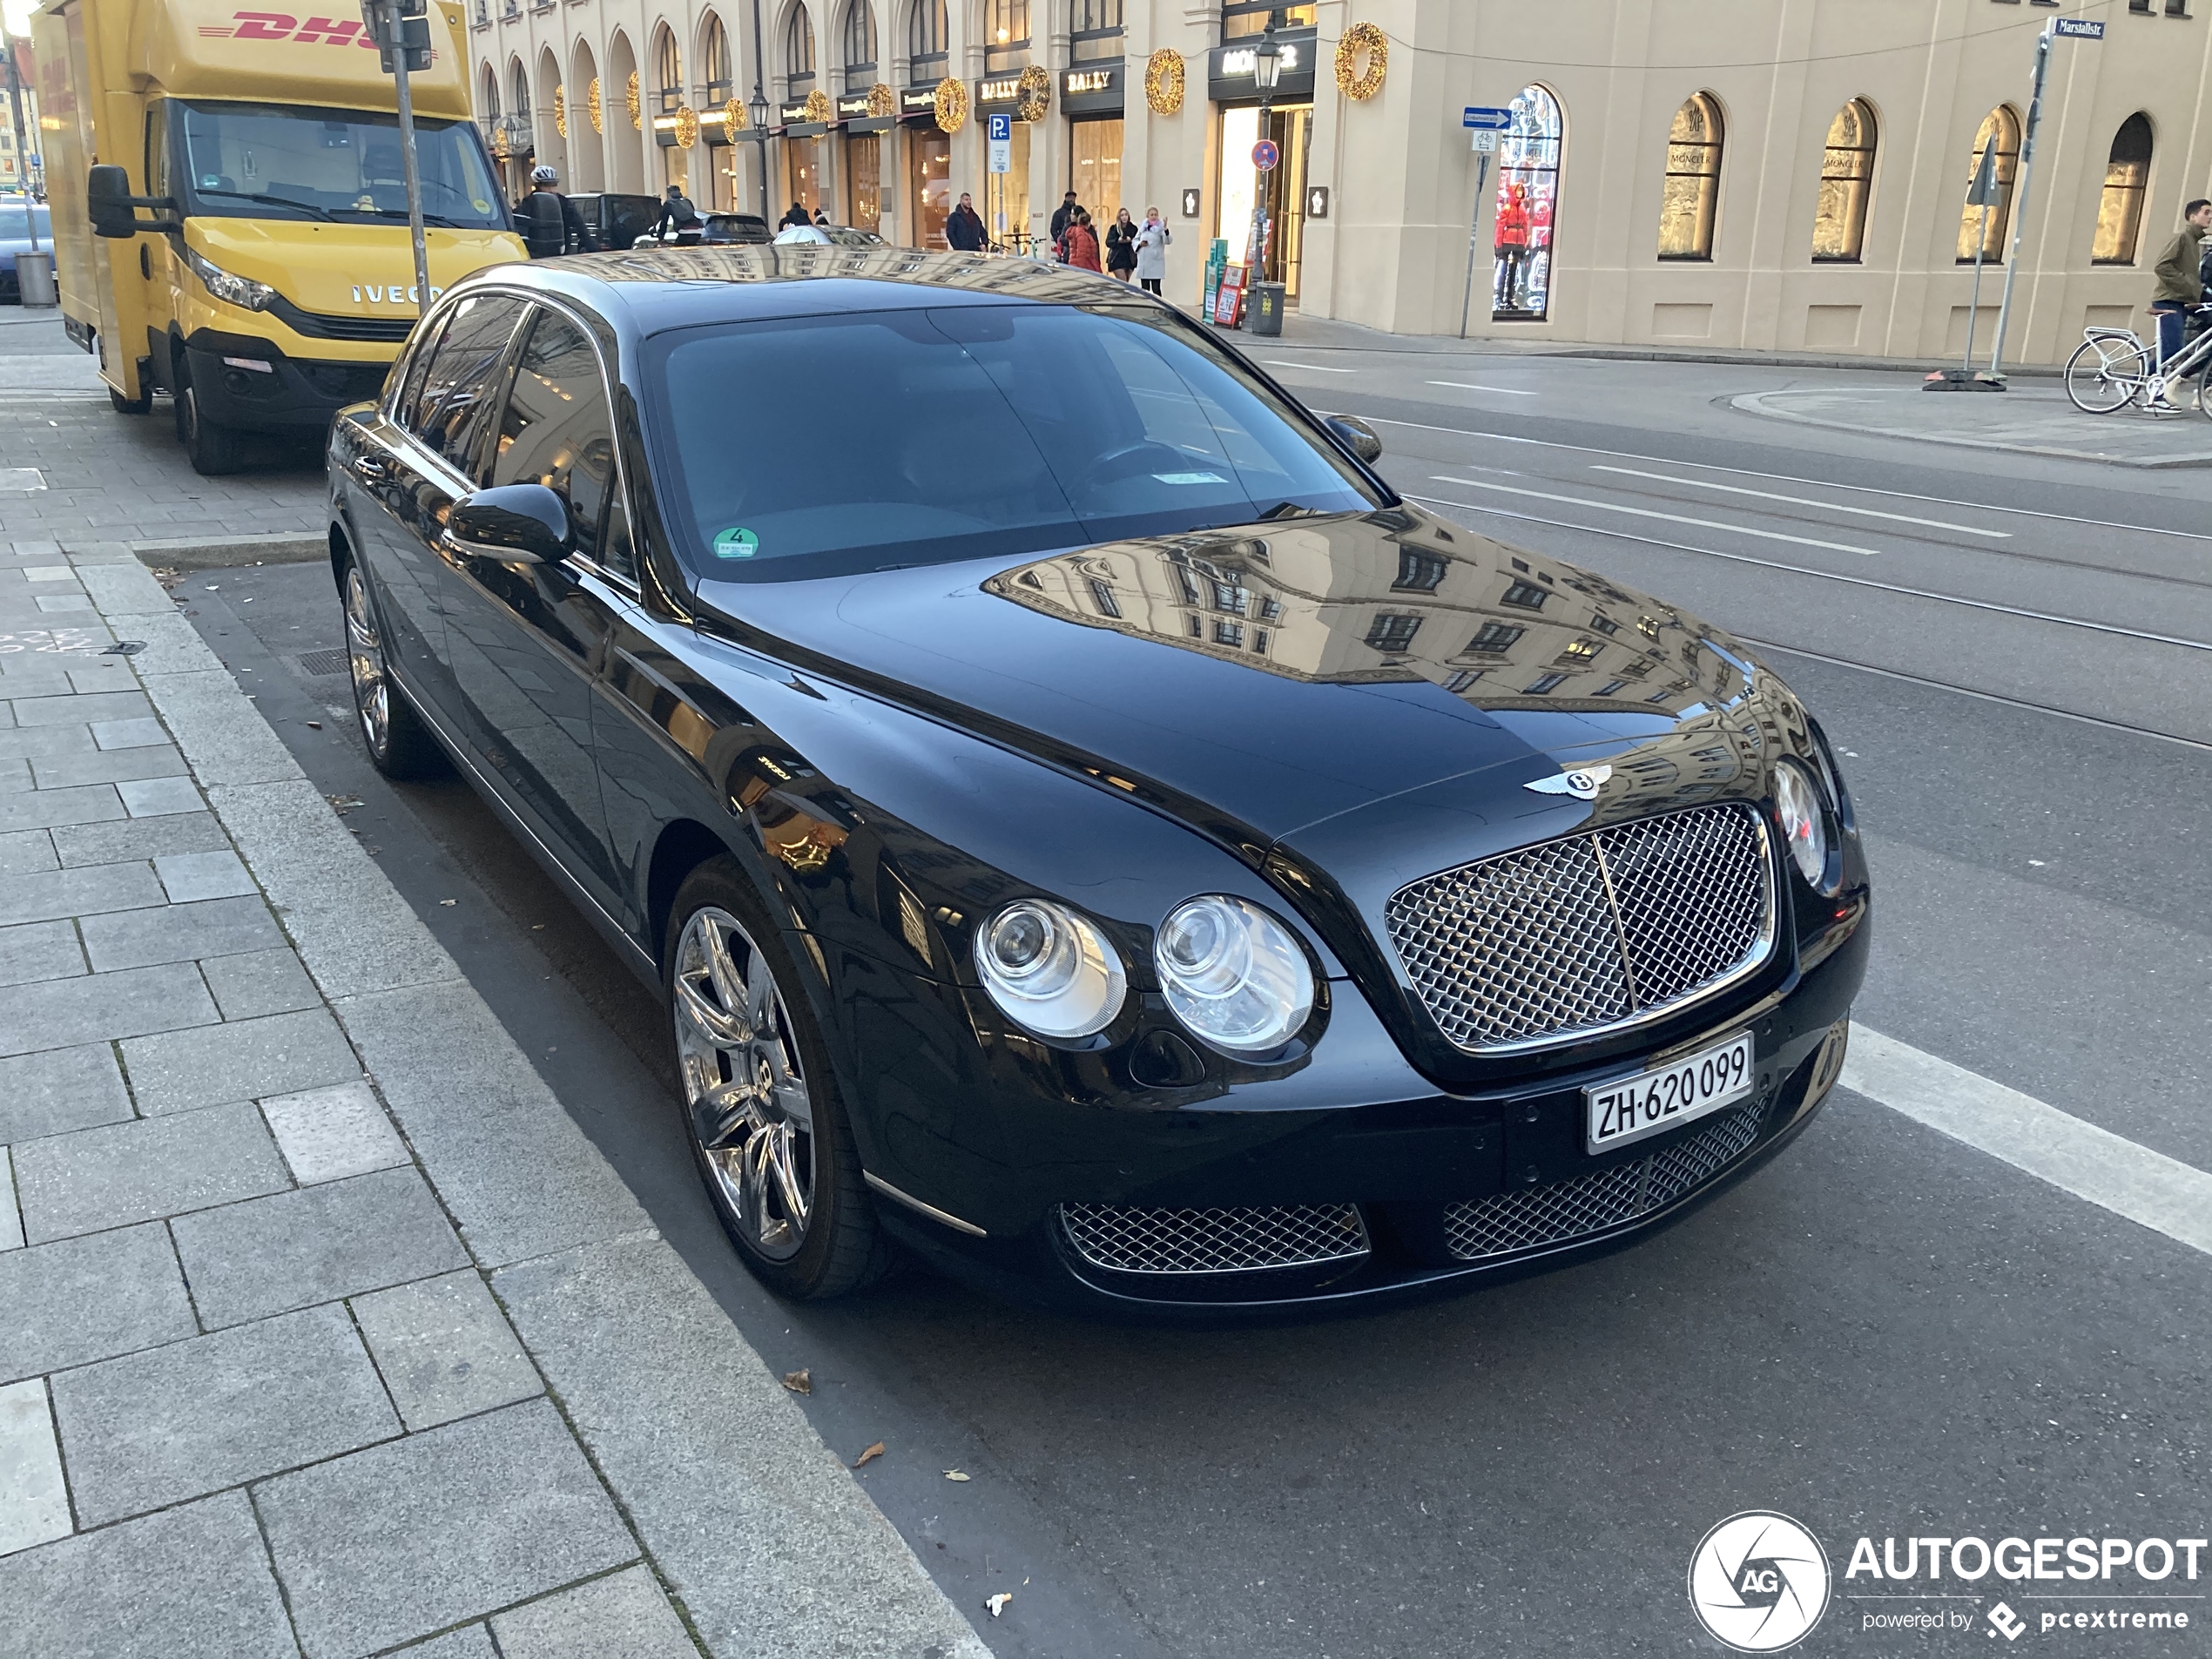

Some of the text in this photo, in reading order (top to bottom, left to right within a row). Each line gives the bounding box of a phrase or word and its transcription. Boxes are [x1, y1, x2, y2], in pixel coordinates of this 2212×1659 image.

[2060, 20, 2101, 35] Marstallstr.
[1068, 71, 1110, 91] BALLY
[981, 80, 1020, 99] BALLY
[1671, 154, 1710, 164] MONCLER
[1825, 159, 1863, 168] MONCLER
[730, 529, 743, 543] 4
